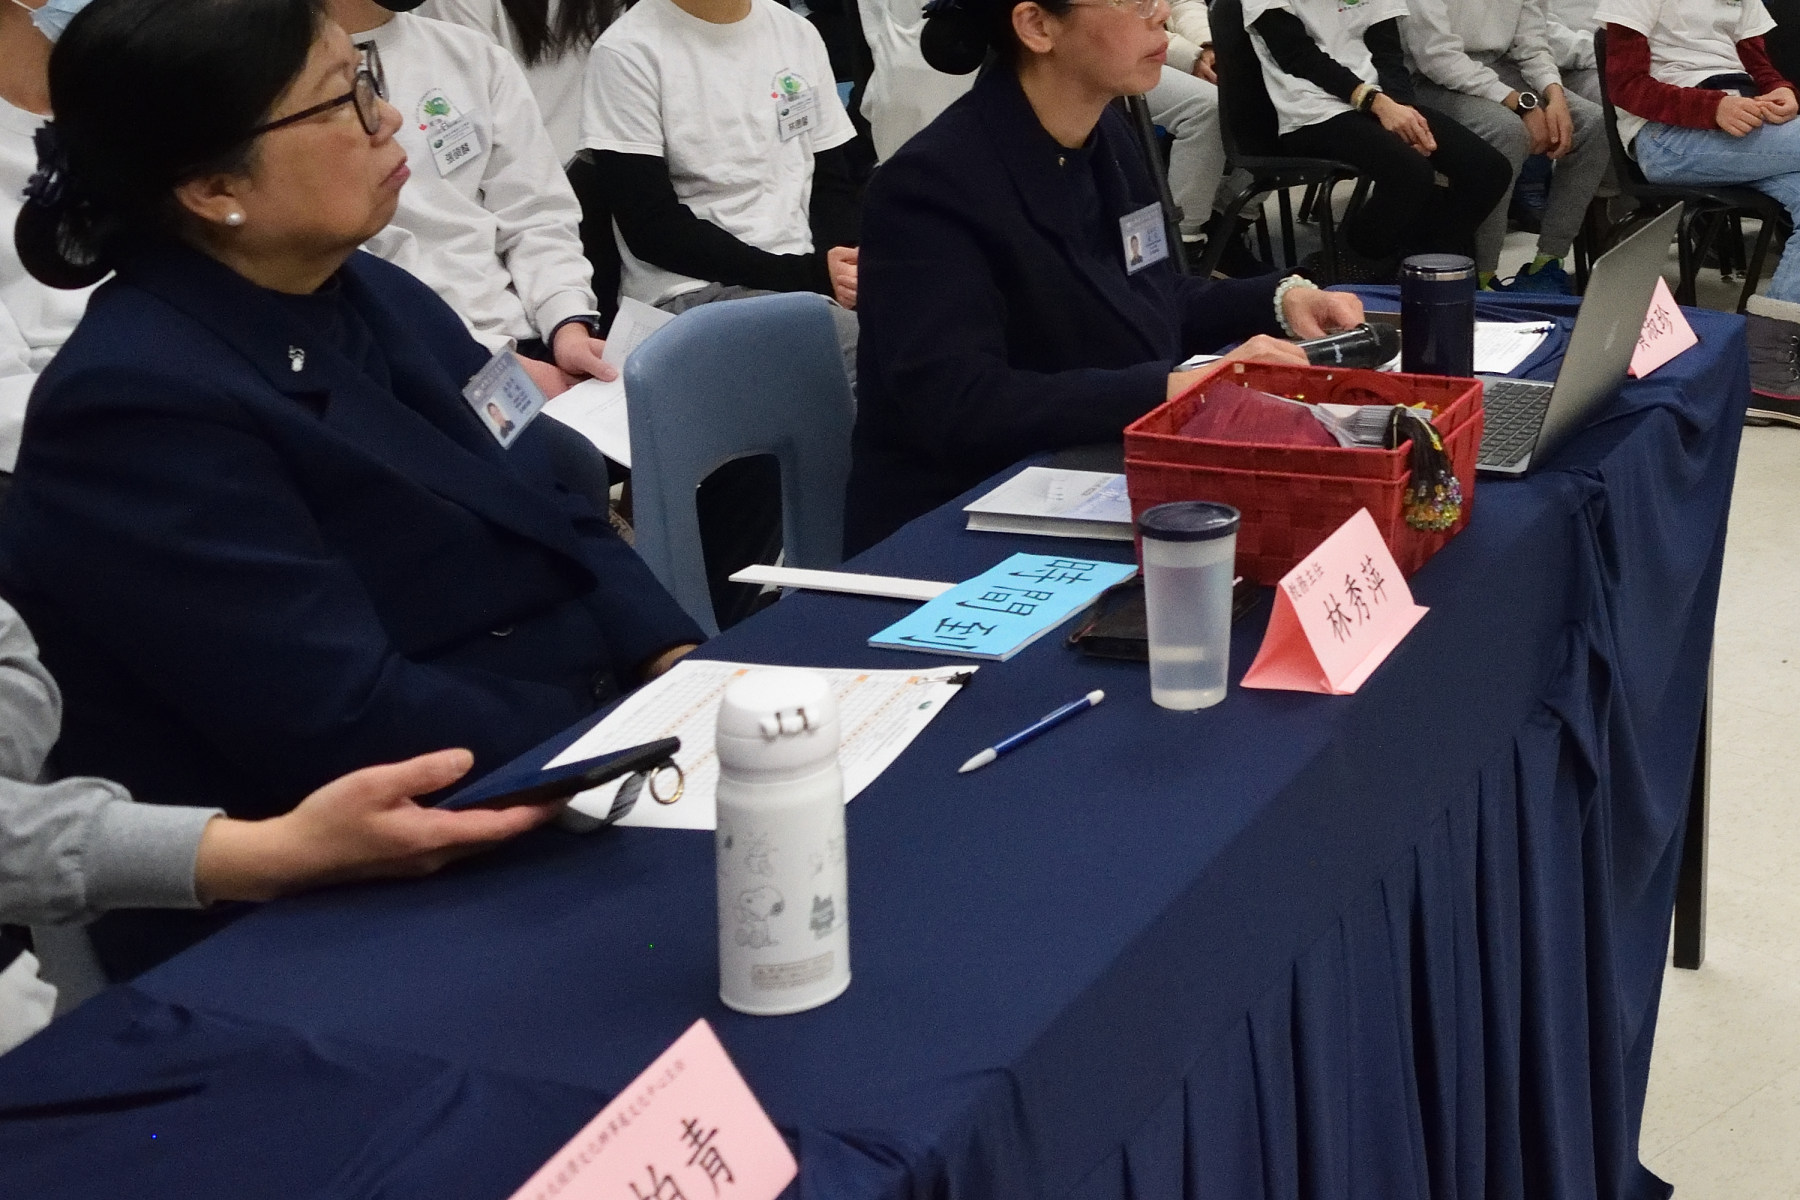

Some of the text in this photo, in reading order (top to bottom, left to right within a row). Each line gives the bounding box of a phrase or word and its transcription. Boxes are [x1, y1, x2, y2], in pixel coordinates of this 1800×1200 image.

[899, 557, 1099, 651] 時間到
[1322, 554, 1388, 644] 林秀萍
